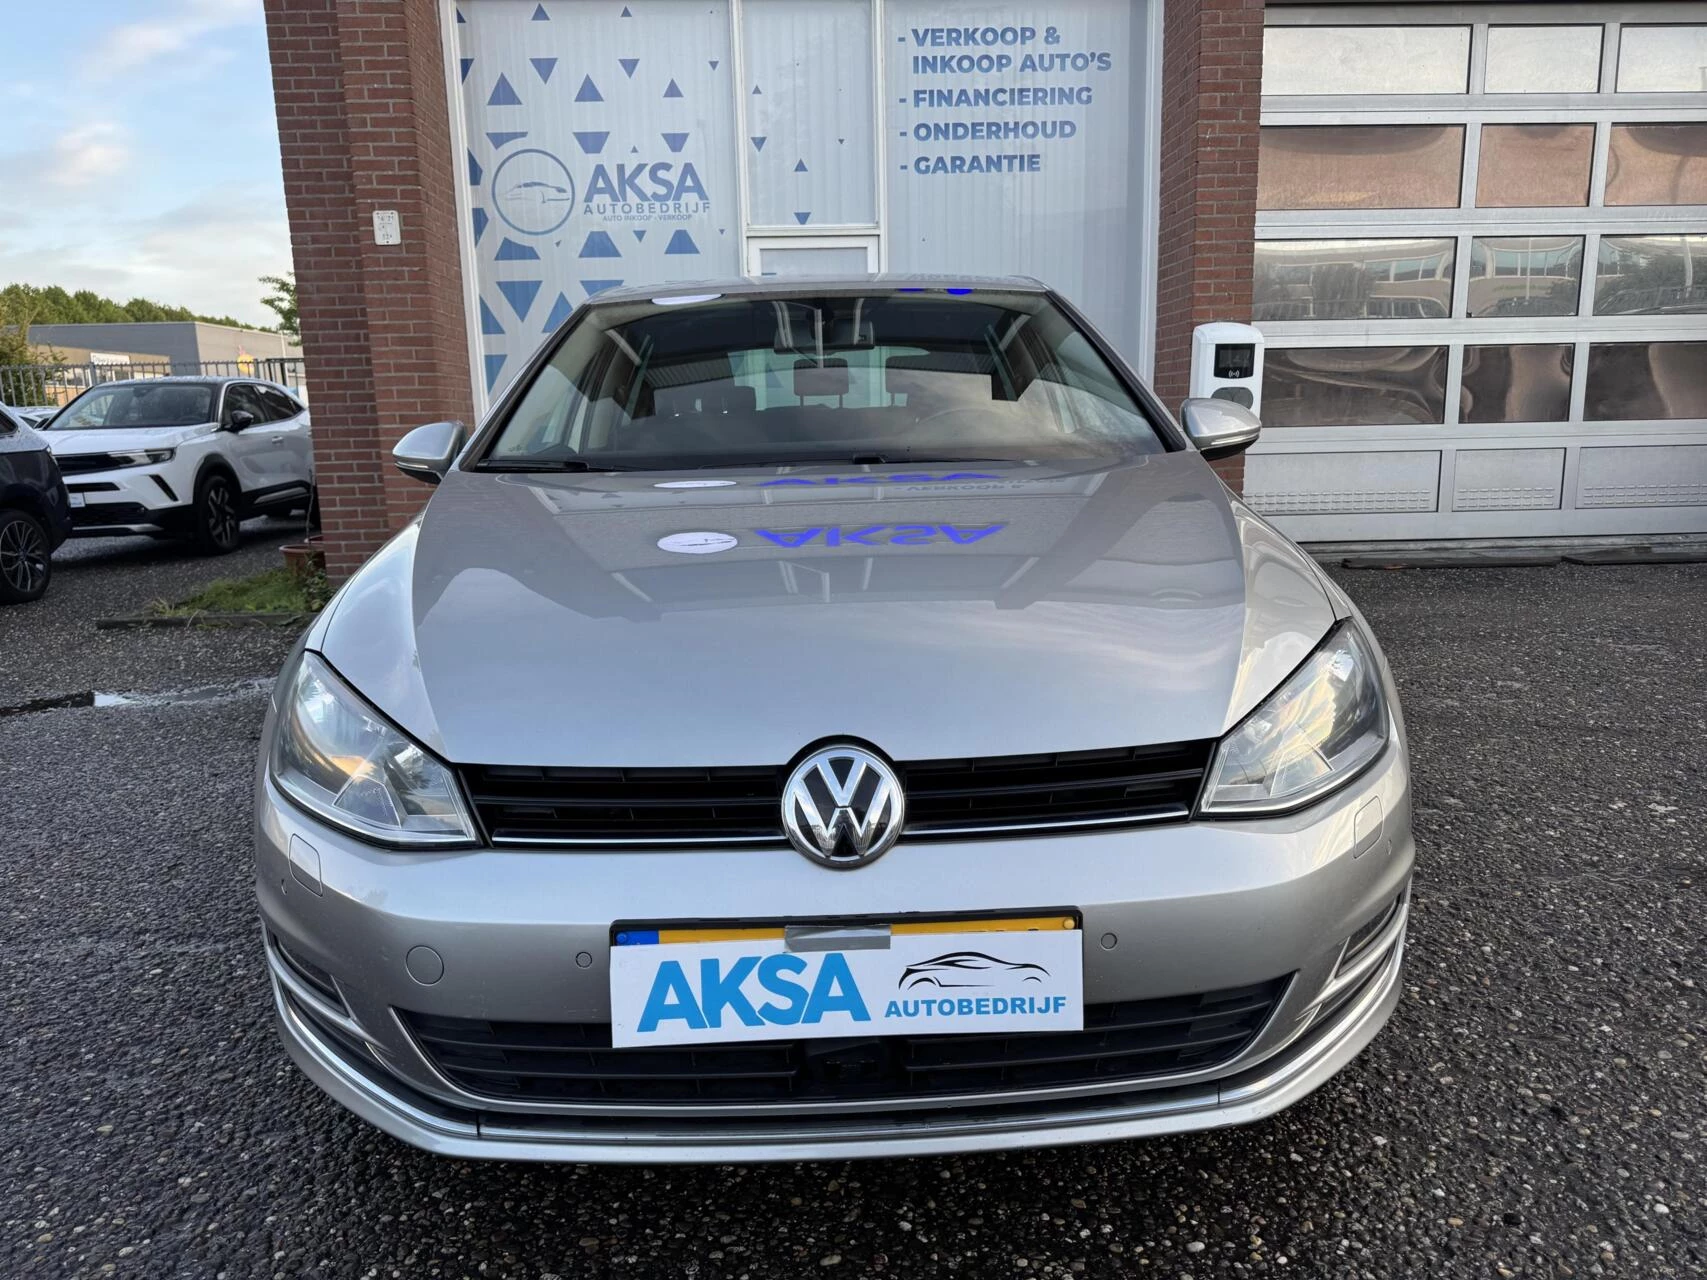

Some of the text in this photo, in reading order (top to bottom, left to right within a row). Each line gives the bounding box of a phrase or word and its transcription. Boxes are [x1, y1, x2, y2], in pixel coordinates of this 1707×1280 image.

[912, 27, 1036, 47] VERKOOP
[1044, 26, 1060, 45] &
[912, 52, 1112, 74] INKOOP AUTO'S
[913, 86, 1093, 108] FINANCIERING
[913, 120, 1077, 142] ONDERHOUD
[914, 153, 1041, 175] GARANTIE
[583, 162, 710, 203] AKSA
[583, 202, 711, 215] AUTOBEDRIJF
[636, 952, 872, 1033] AKSA
[884, 996, 1067, 1018] AUTOBEDRIJF
